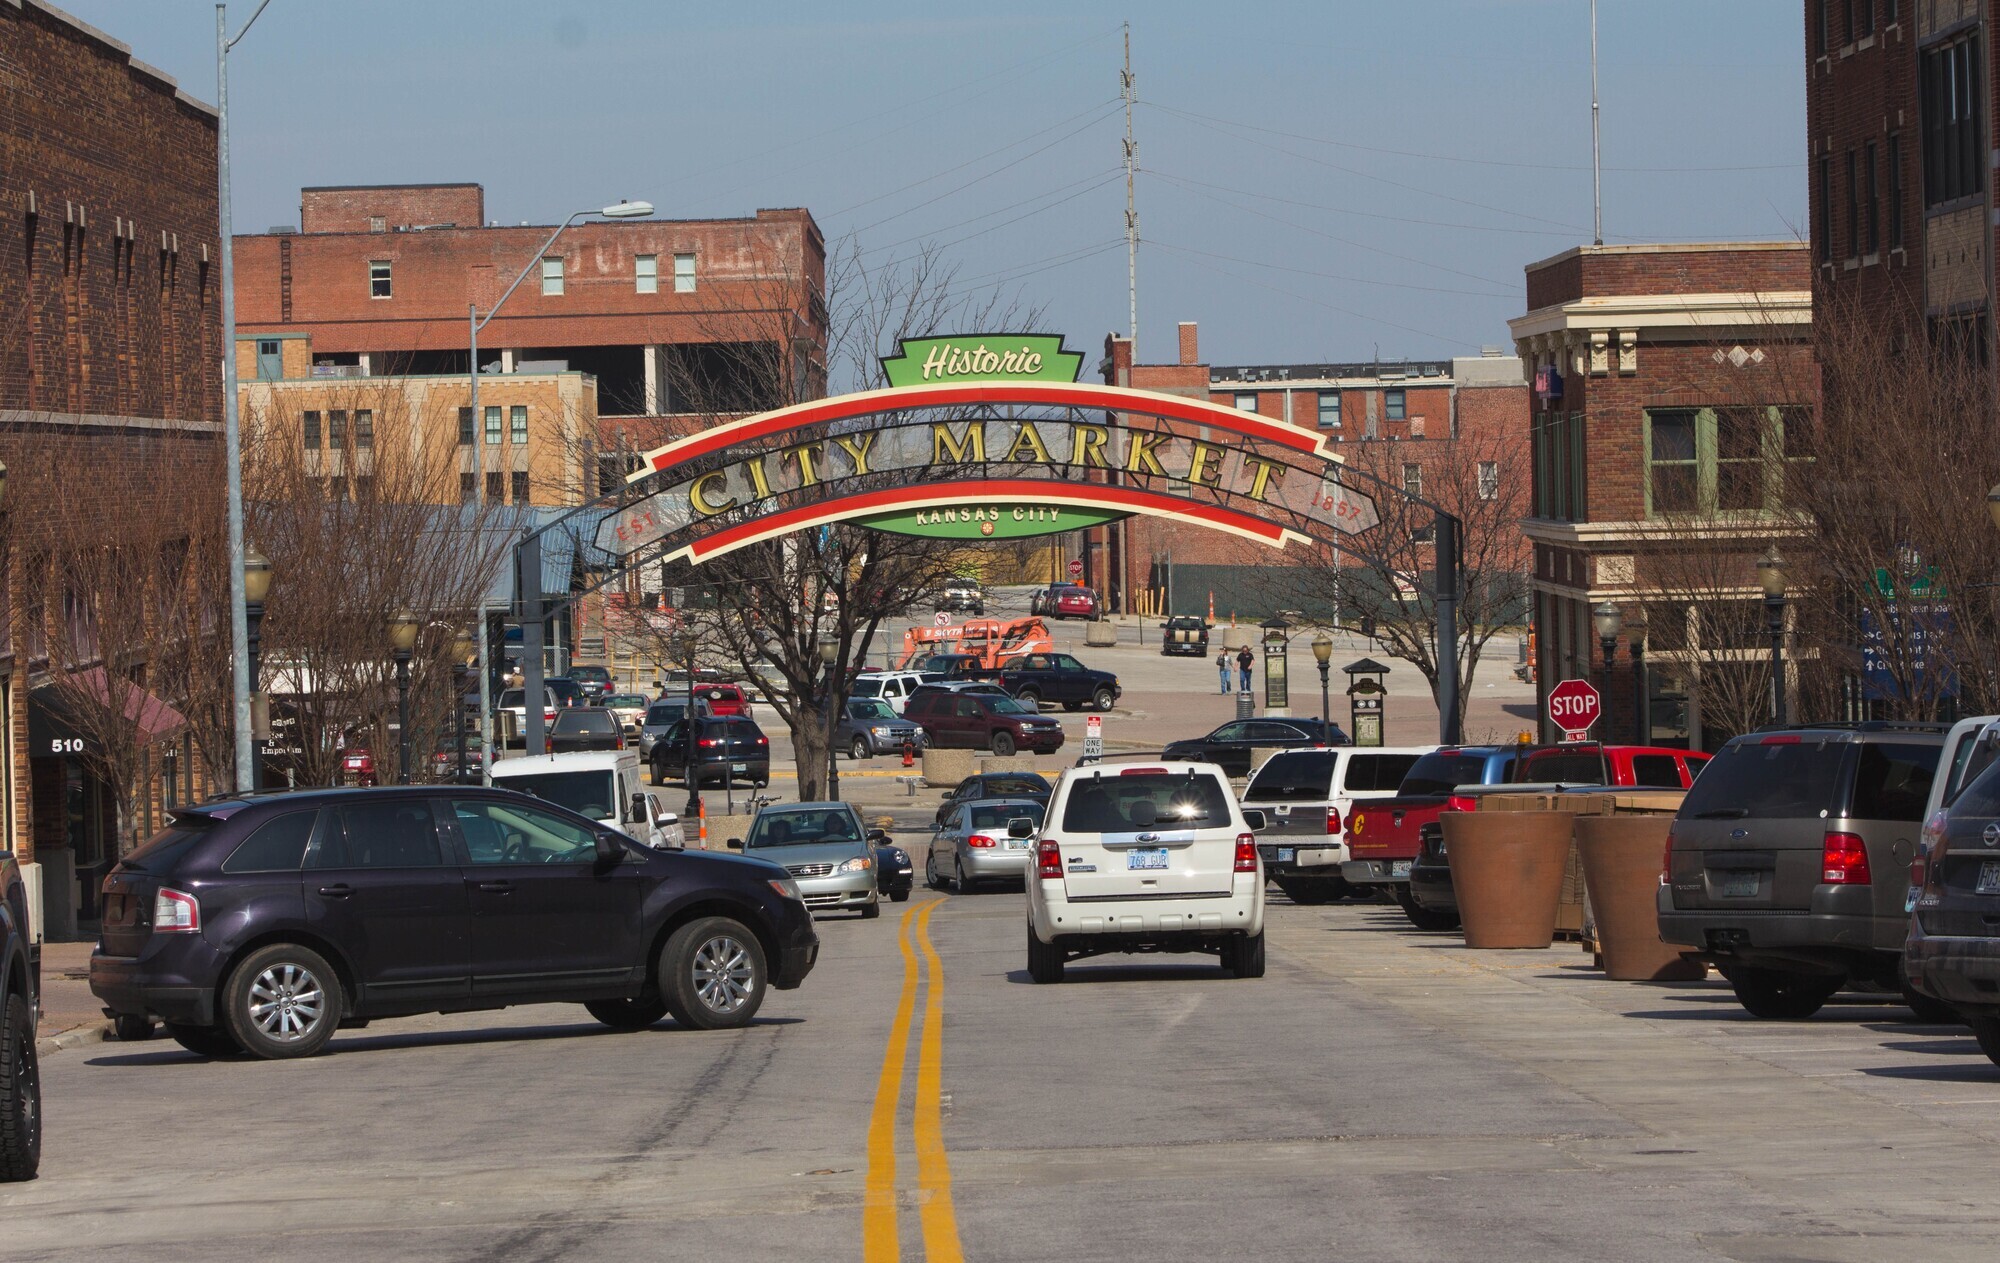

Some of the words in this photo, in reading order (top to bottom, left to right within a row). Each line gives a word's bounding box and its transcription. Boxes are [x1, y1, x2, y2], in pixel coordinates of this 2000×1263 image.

[922, 343, 1043, 380] Historic
[689, 430, 879, 516] CITY
[929, 420, 1288, 502] MARKET
[1309, 491, 1362, 520] 1857
[916, 506, 999, 526] KANSAS
[1012, 506, 1060, 522] CITY
[1068, 564, 1082, 572] STOP
[1553, 694, 1596, 716] STOP
[268, 739, 275, 747] &
[1567, 733, 1575, 741] ALL
[1575, 733, 1585, 741] WAY
[52, 739, 84, 753] 510
[1130, 855, 1146, 867] 768
